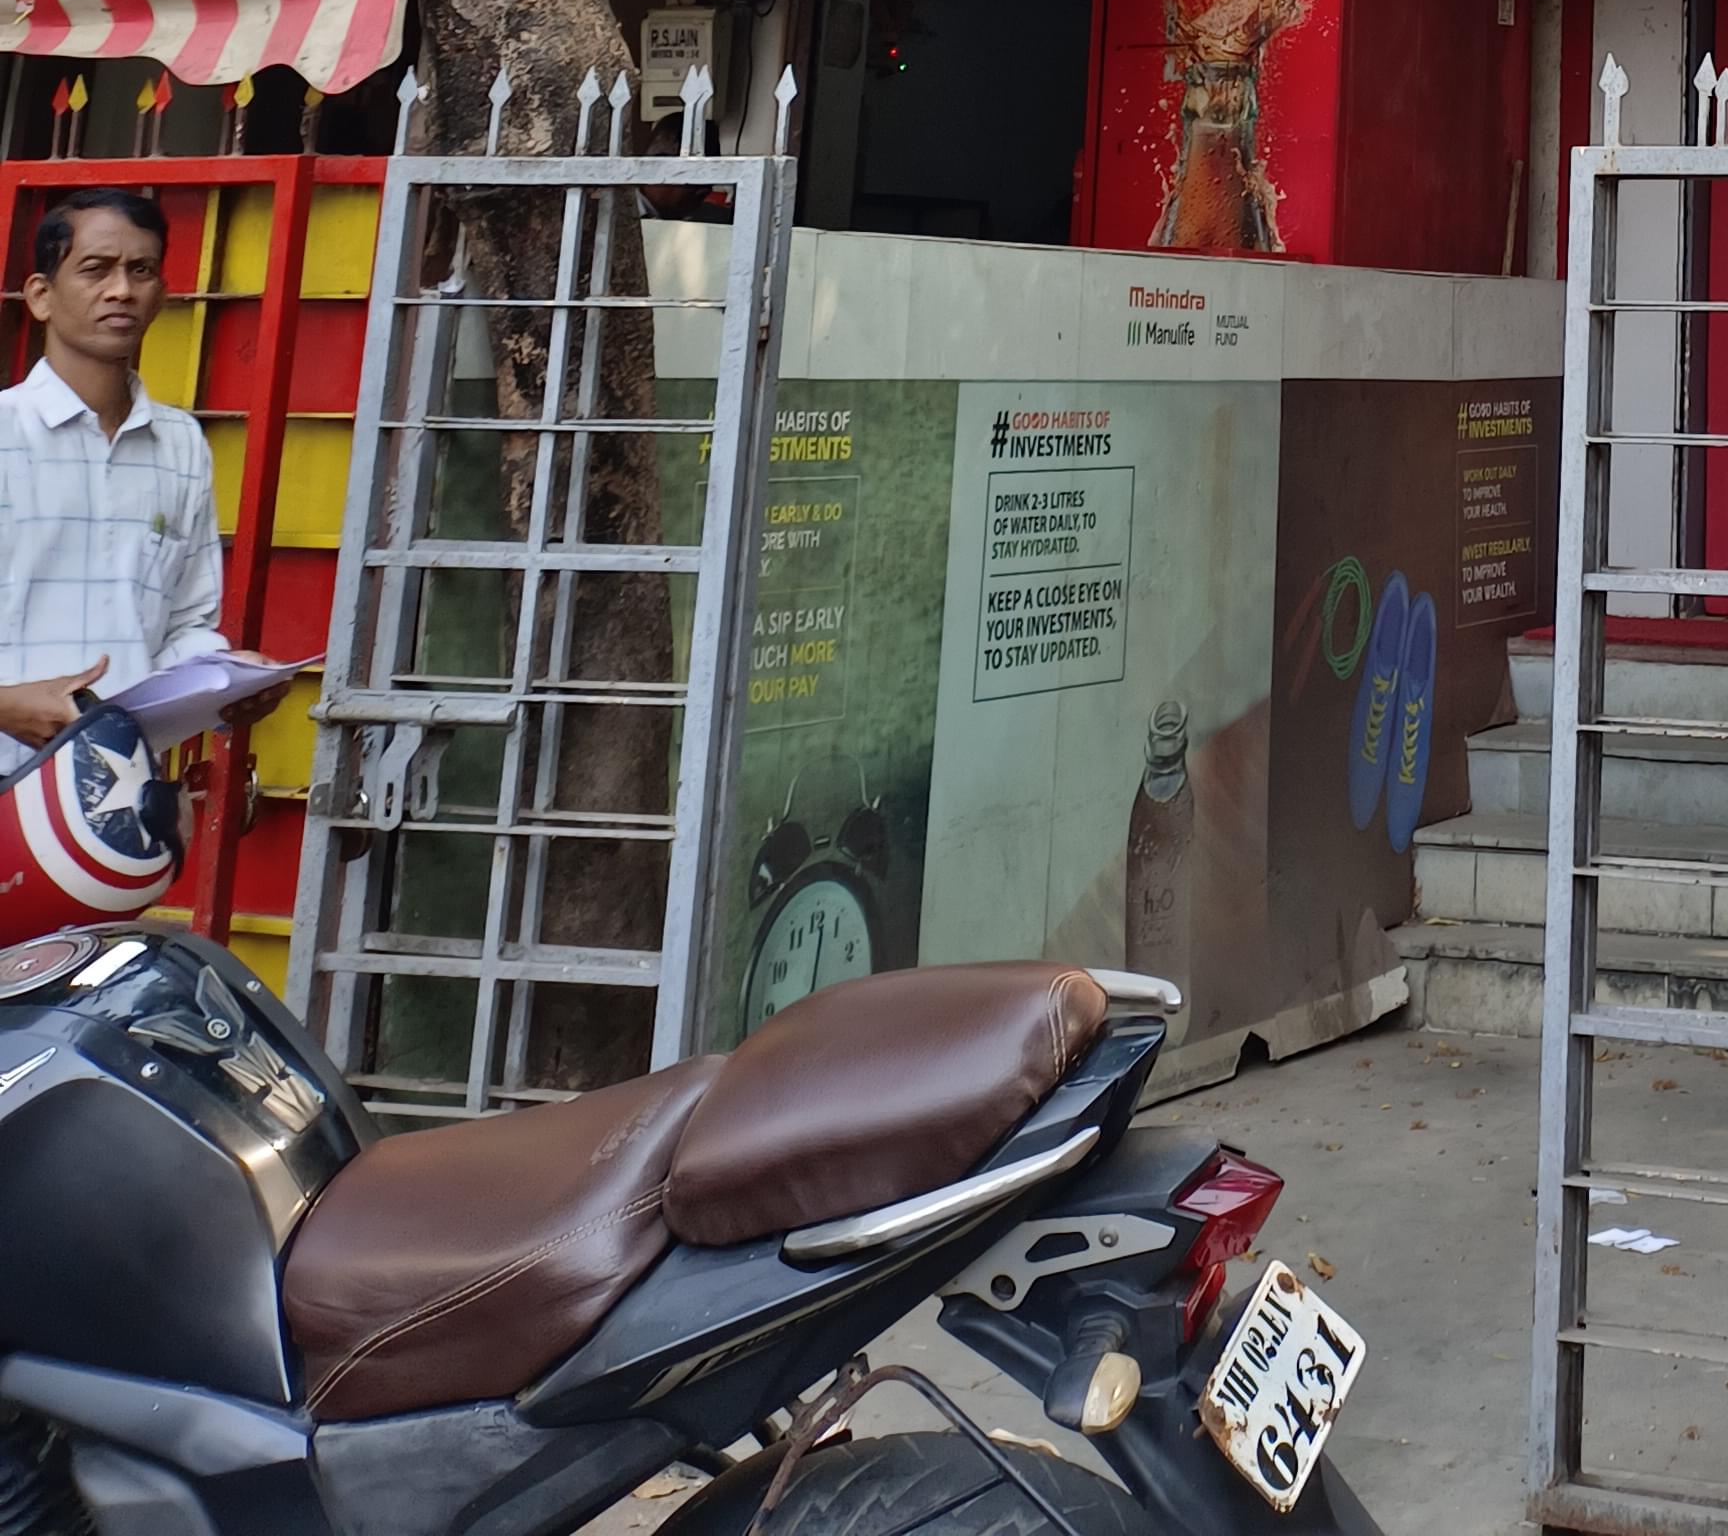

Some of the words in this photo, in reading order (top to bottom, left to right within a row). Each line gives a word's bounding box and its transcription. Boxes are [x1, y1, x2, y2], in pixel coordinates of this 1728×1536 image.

[1145, 321, 1196, 346] Manulife
[1215, 314, 1250, 330] MUTUAL
[1214, 332, 1239, 346] FUND
[1012, 411, 1050, 431] GOOD
[1051, 410, 1094, 429] HABITS
[1094, 410, 1112, 429] OF
[1493, 400, 1520, 417] HABITS
[1520, 399, 1533, 415] OF
[775, 410, 828, 433] HABITS
[831, 410, 852, 431] OF
[1468, 417, 1534, 440] INVESTMENTS
[769, 435, 853, 462] STMENTS
[1009, 433, 1112, 460] INVESTMENTS
[769, 504, 811, 525] EARLY
[824, 502, 843, 521] DO
[994, 493, 1031, 513] DRINK
[1031, 492, 1049, 511] 2-3
[1050, 490, 1086, 508] LITRES
[993, 518, 1010, 536] OF
[1010, 514, 1048, 536] WATER
[1048, 512, 1082, 534] DAILY,
[1082, 511, 1097, 530] TO
[787, 529, 821, 551] WITH
[991, 540, 1020, 560] STAY
[1020, 536, 1080, 558] HYDRATED.
[1461, 542, 1488, 562] INVEST
[1462, 566, 1474, 583] TO
[1474, 560, 1508, 580] IMPROVE
[987, 589, 1022, 614] KEEP
[1023, 589, 1034, 610] A
[1036, 584, 1077, 609] CLOSE
[1077, 582, 1102, 604] EYE
[1102, 579, 1123, 603] ON
[1462, 587, 1484, 605] YOUR
[768, 611, 791, 635] SIP
[795, 605, 846, 632] EARLY
[986, 617, 1025, 643] YOUR
[1026, 606, 1119, 638] INVESTMENTS,
[752, 643, 788, 670] UCH
[790, 639, 837, 666] MORE
[984, 647, 1003, 671] TO
[1004, 644, 1039, 669] STAY
[1040, 636, 1102, 664] UPDATED.
[748, 679, 786, 704] OUR
[787, 674, 819, 699] PAY
[809, 909, 825, 934] 12
[772, 959, 788, 985] 10
[1256, 1313, 1357, 1492] 6431
